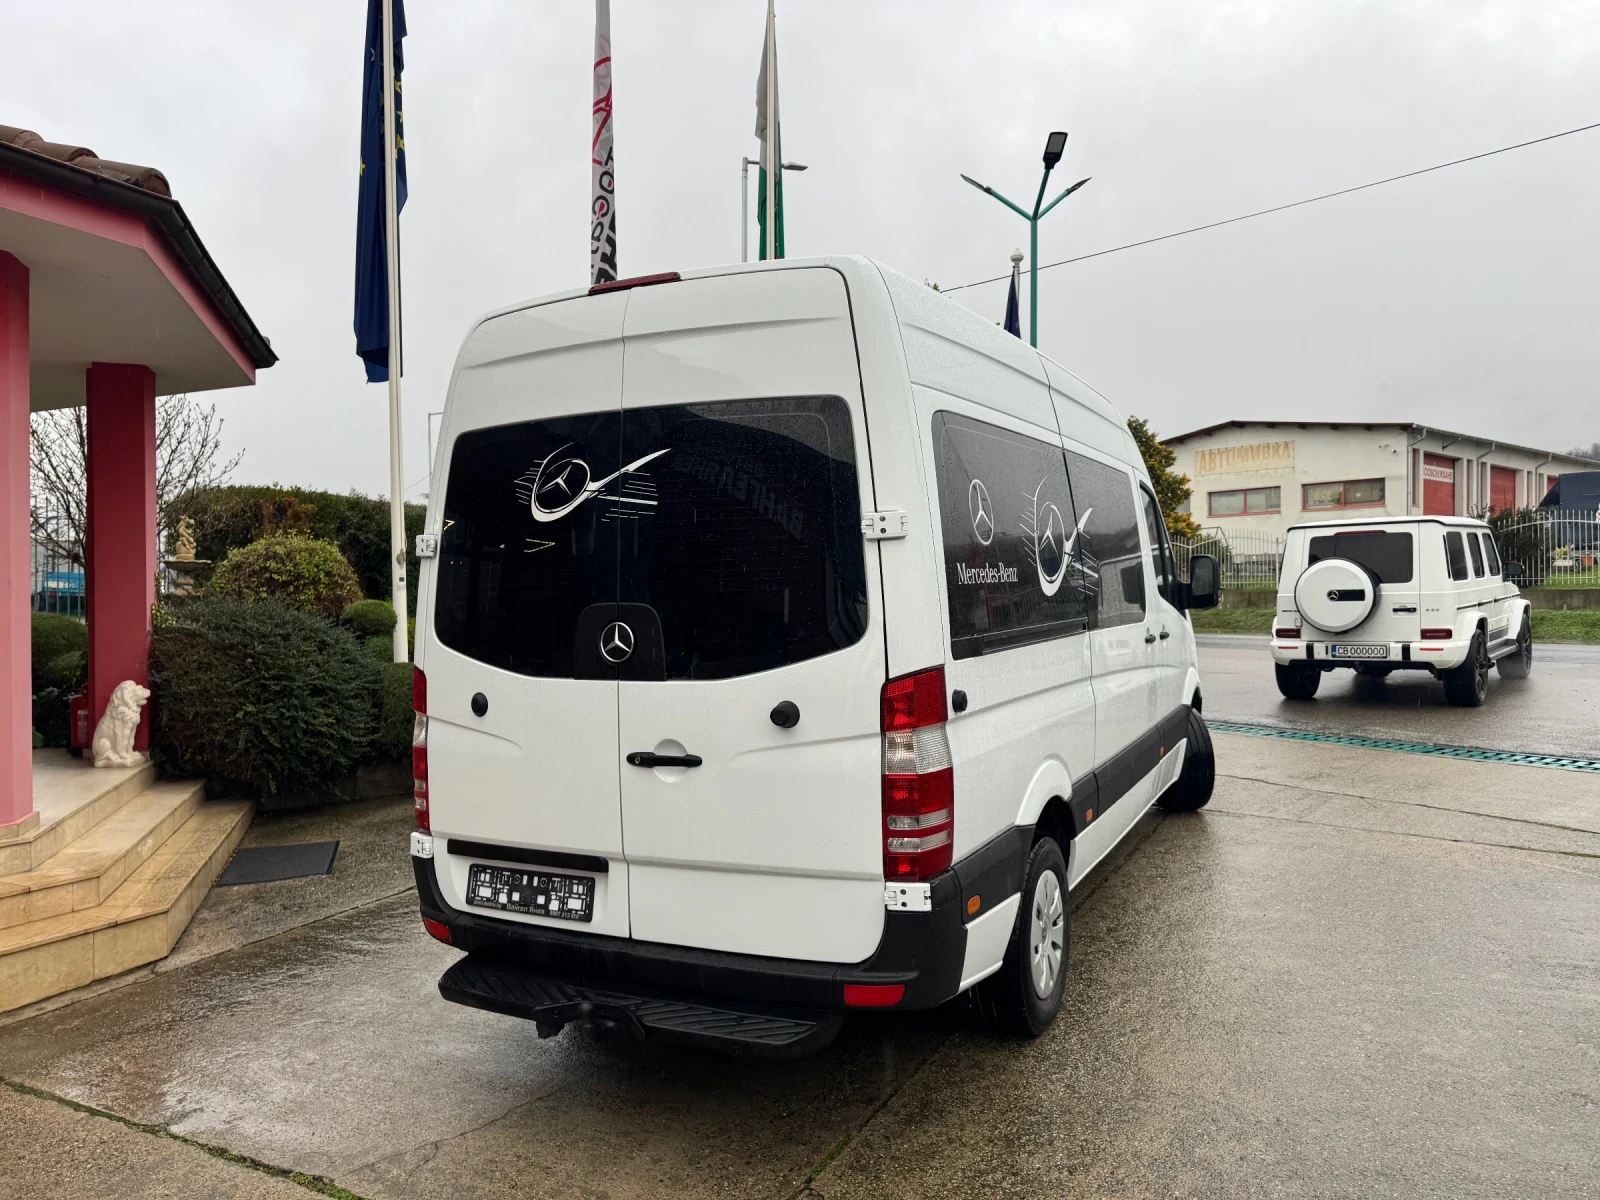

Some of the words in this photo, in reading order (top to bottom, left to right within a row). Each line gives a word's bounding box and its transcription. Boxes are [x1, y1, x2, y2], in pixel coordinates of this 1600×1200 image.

[1198, 442, 1291, 474] АВТОМИВКА
[956, 562, 1019, 584] Mercedes-Benz
[1337, 646, 1349, 655] CB
[1350, 646, 1385, 656] 000000
